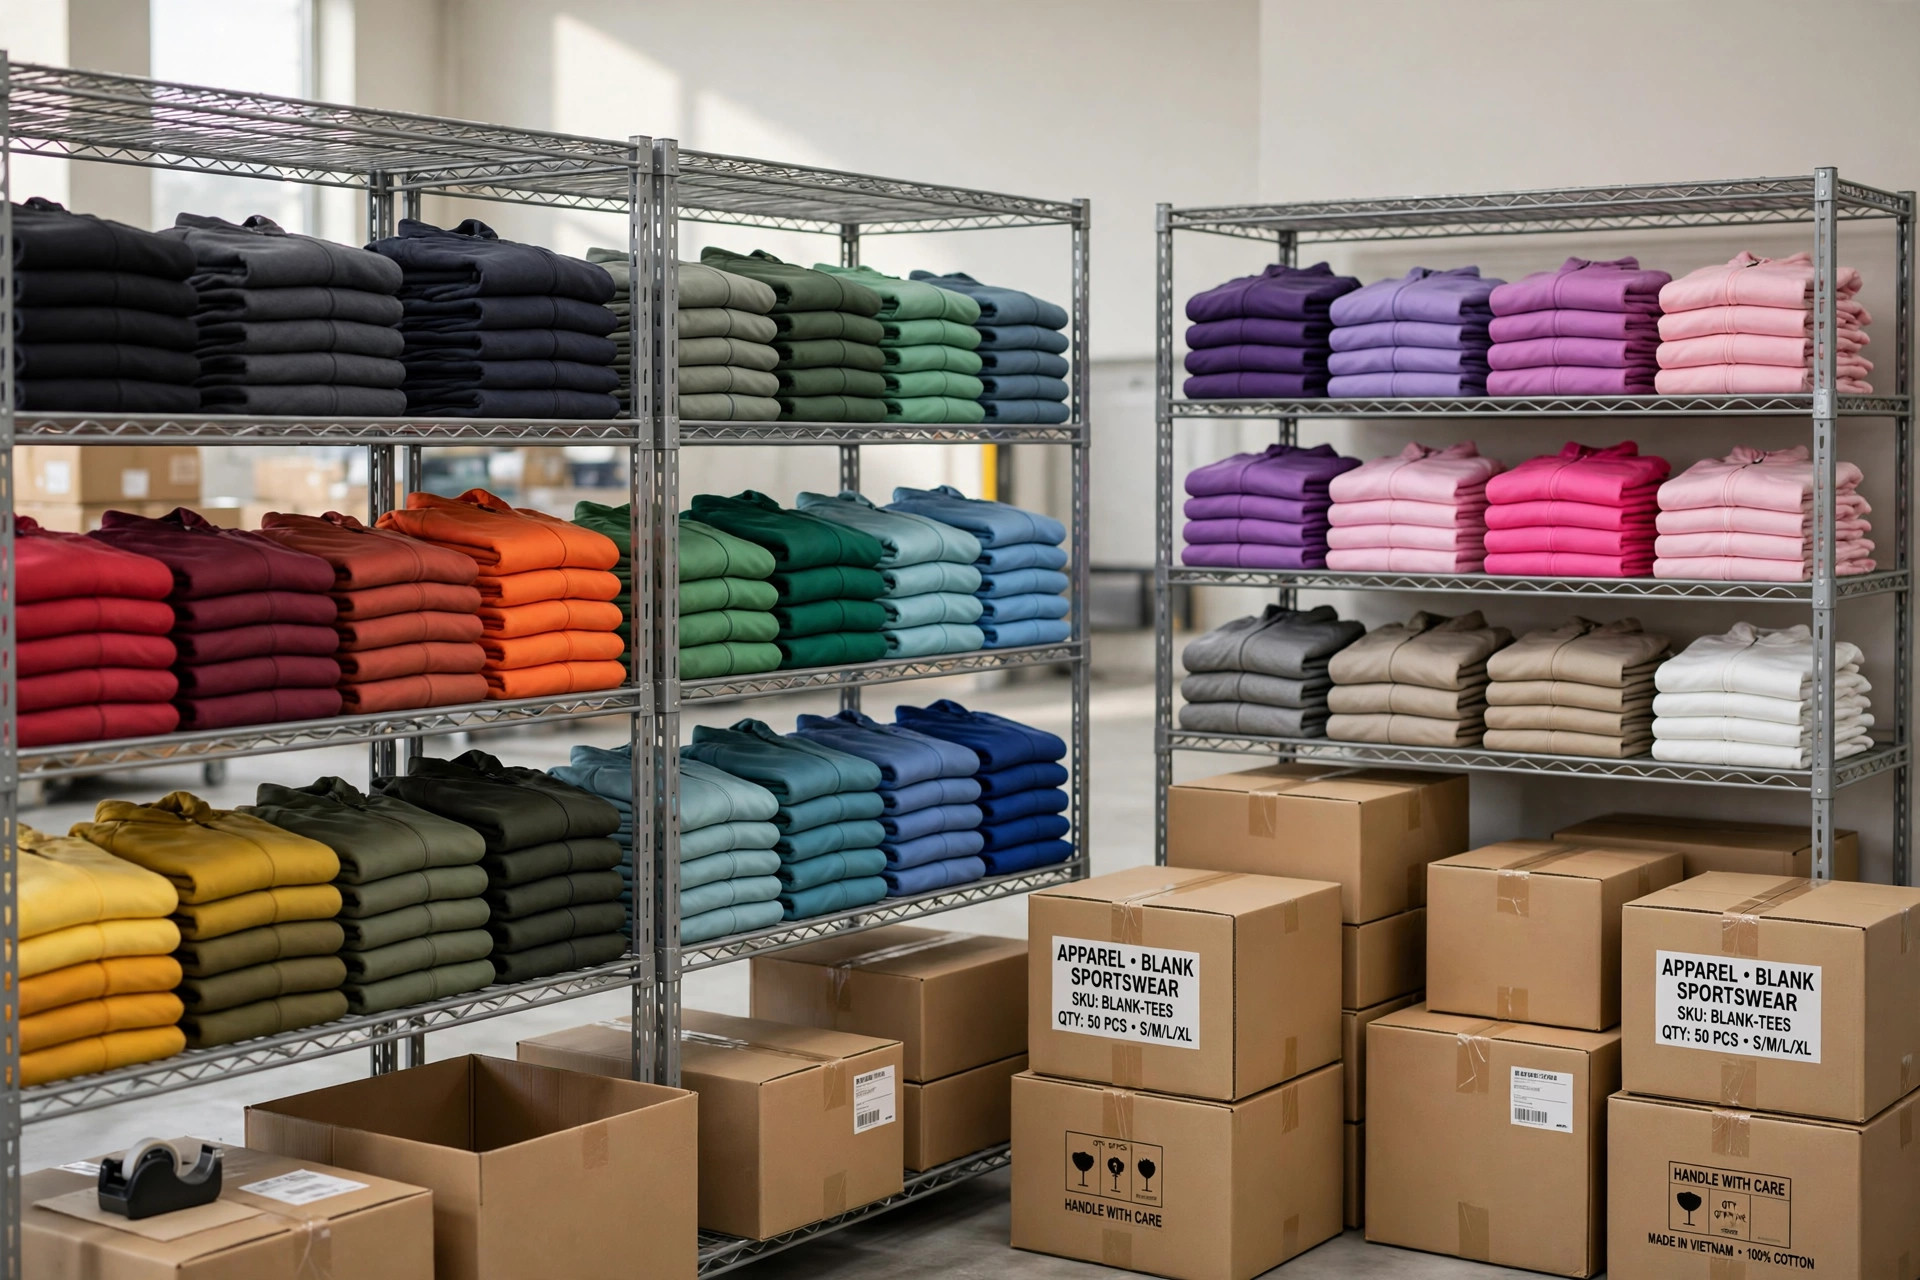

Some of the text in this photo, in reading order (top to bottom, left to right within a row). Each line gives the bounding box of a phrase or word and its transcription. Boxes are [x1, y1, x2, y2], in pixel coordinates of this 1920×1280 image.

[1057, 944, 1194, 977] APPAREL BLANK
[1662, 958, 1814, 991] APPAREL BLANK
[1071, 967, 1179, 998] SPORTSWEAR
[1677, 982, 1797, 1011] SPORTSWEAR
[1072, 992, 1173, 1018] SKU: BLANK-TEES
[1678, 1006, 1791, 1032] SKU: BLANK-TEES
[1058, 1011, 1192, 1041] QTY: 50 PCS S/M/L/XL
[1662, 1025, 1811, 1055] QTY: 50 PCS S/M/L/XL
[1674, 1168, 1785, 1196] HANDLE WITH CARE
[1065, 1198, 1162, 1227] HANDLE WITH CARE
[1648, 1233, 1814, 1269] MADE IN VIETNAM 100% COTTON
